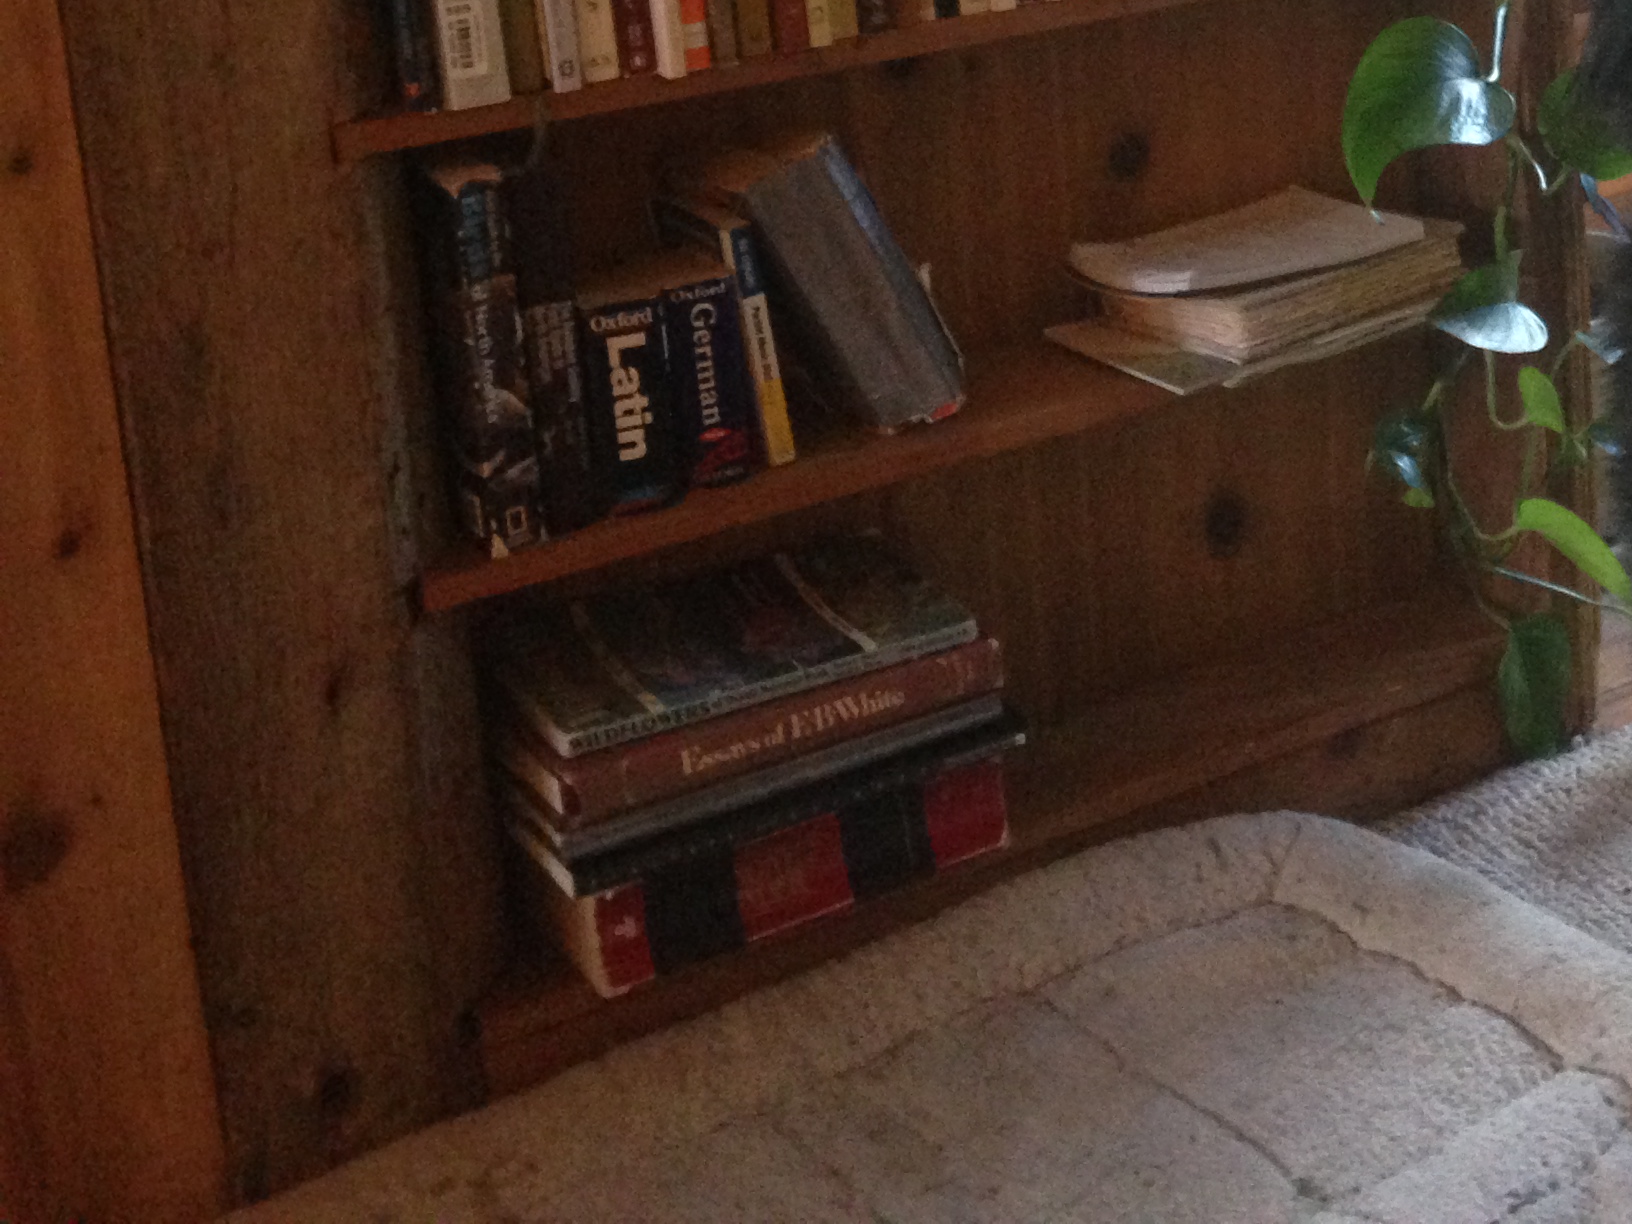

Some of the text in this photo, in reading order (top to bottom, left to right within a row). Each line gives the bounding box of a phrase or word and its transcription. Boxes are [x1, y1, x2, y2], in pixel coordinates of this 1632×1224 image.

[588, 305, 654, 333] Oxford
[668, 281, 727, 304] Oxford
[473, 303, 494, 356] North
[689, 300, 725, 427] German
[605, 330, 657, 461] Latin
[676, 725, 762, 775] Essays
[758, 719, 789, 748] of
